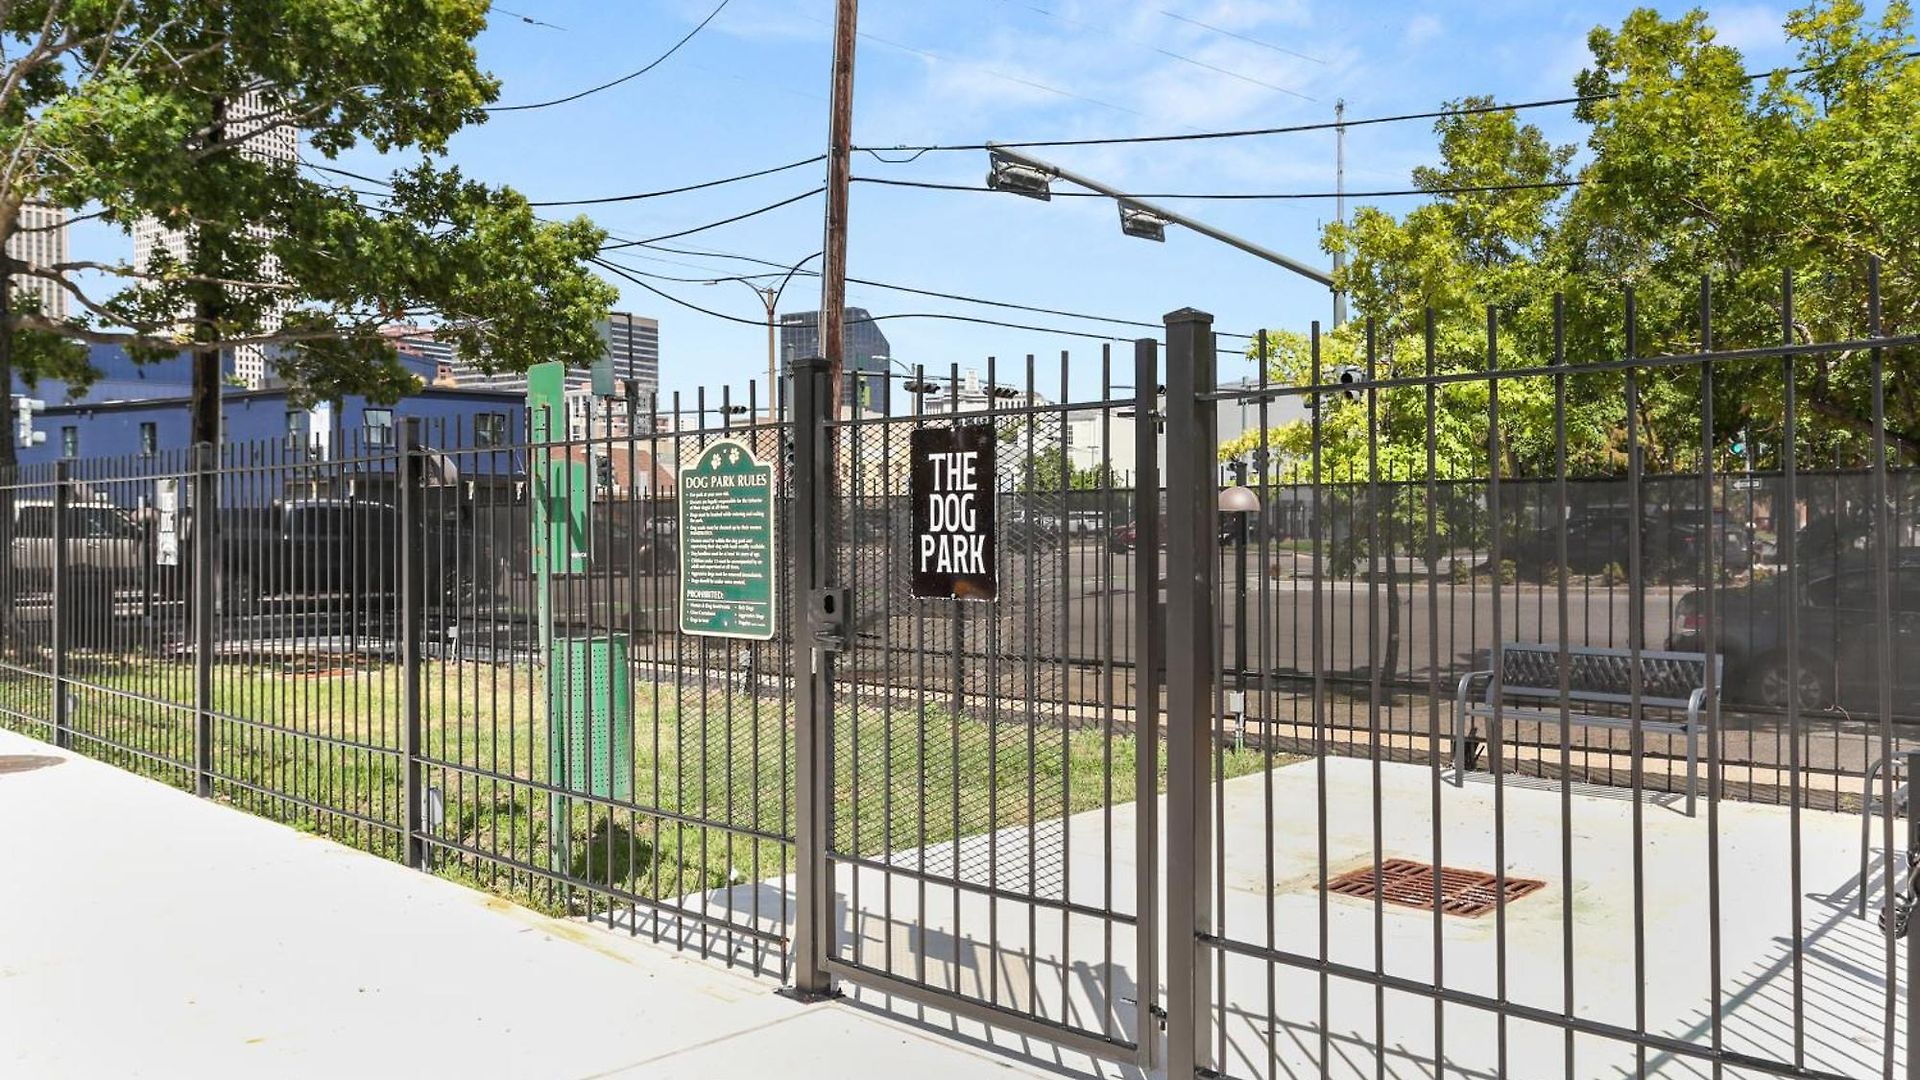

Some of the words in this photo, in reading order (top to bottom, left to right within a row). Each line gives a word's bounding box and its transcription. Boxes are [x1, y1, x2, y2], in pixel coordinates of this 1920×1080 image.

[685, 476, 708, 489] DOG
[711, 474, 735, 488] PARK
[738, 473, 767, 487] RULES
[928, 451, 978, 491] THE
[929, 493, 976, 533] DOG
[921, 534, 986, 574] PARK
